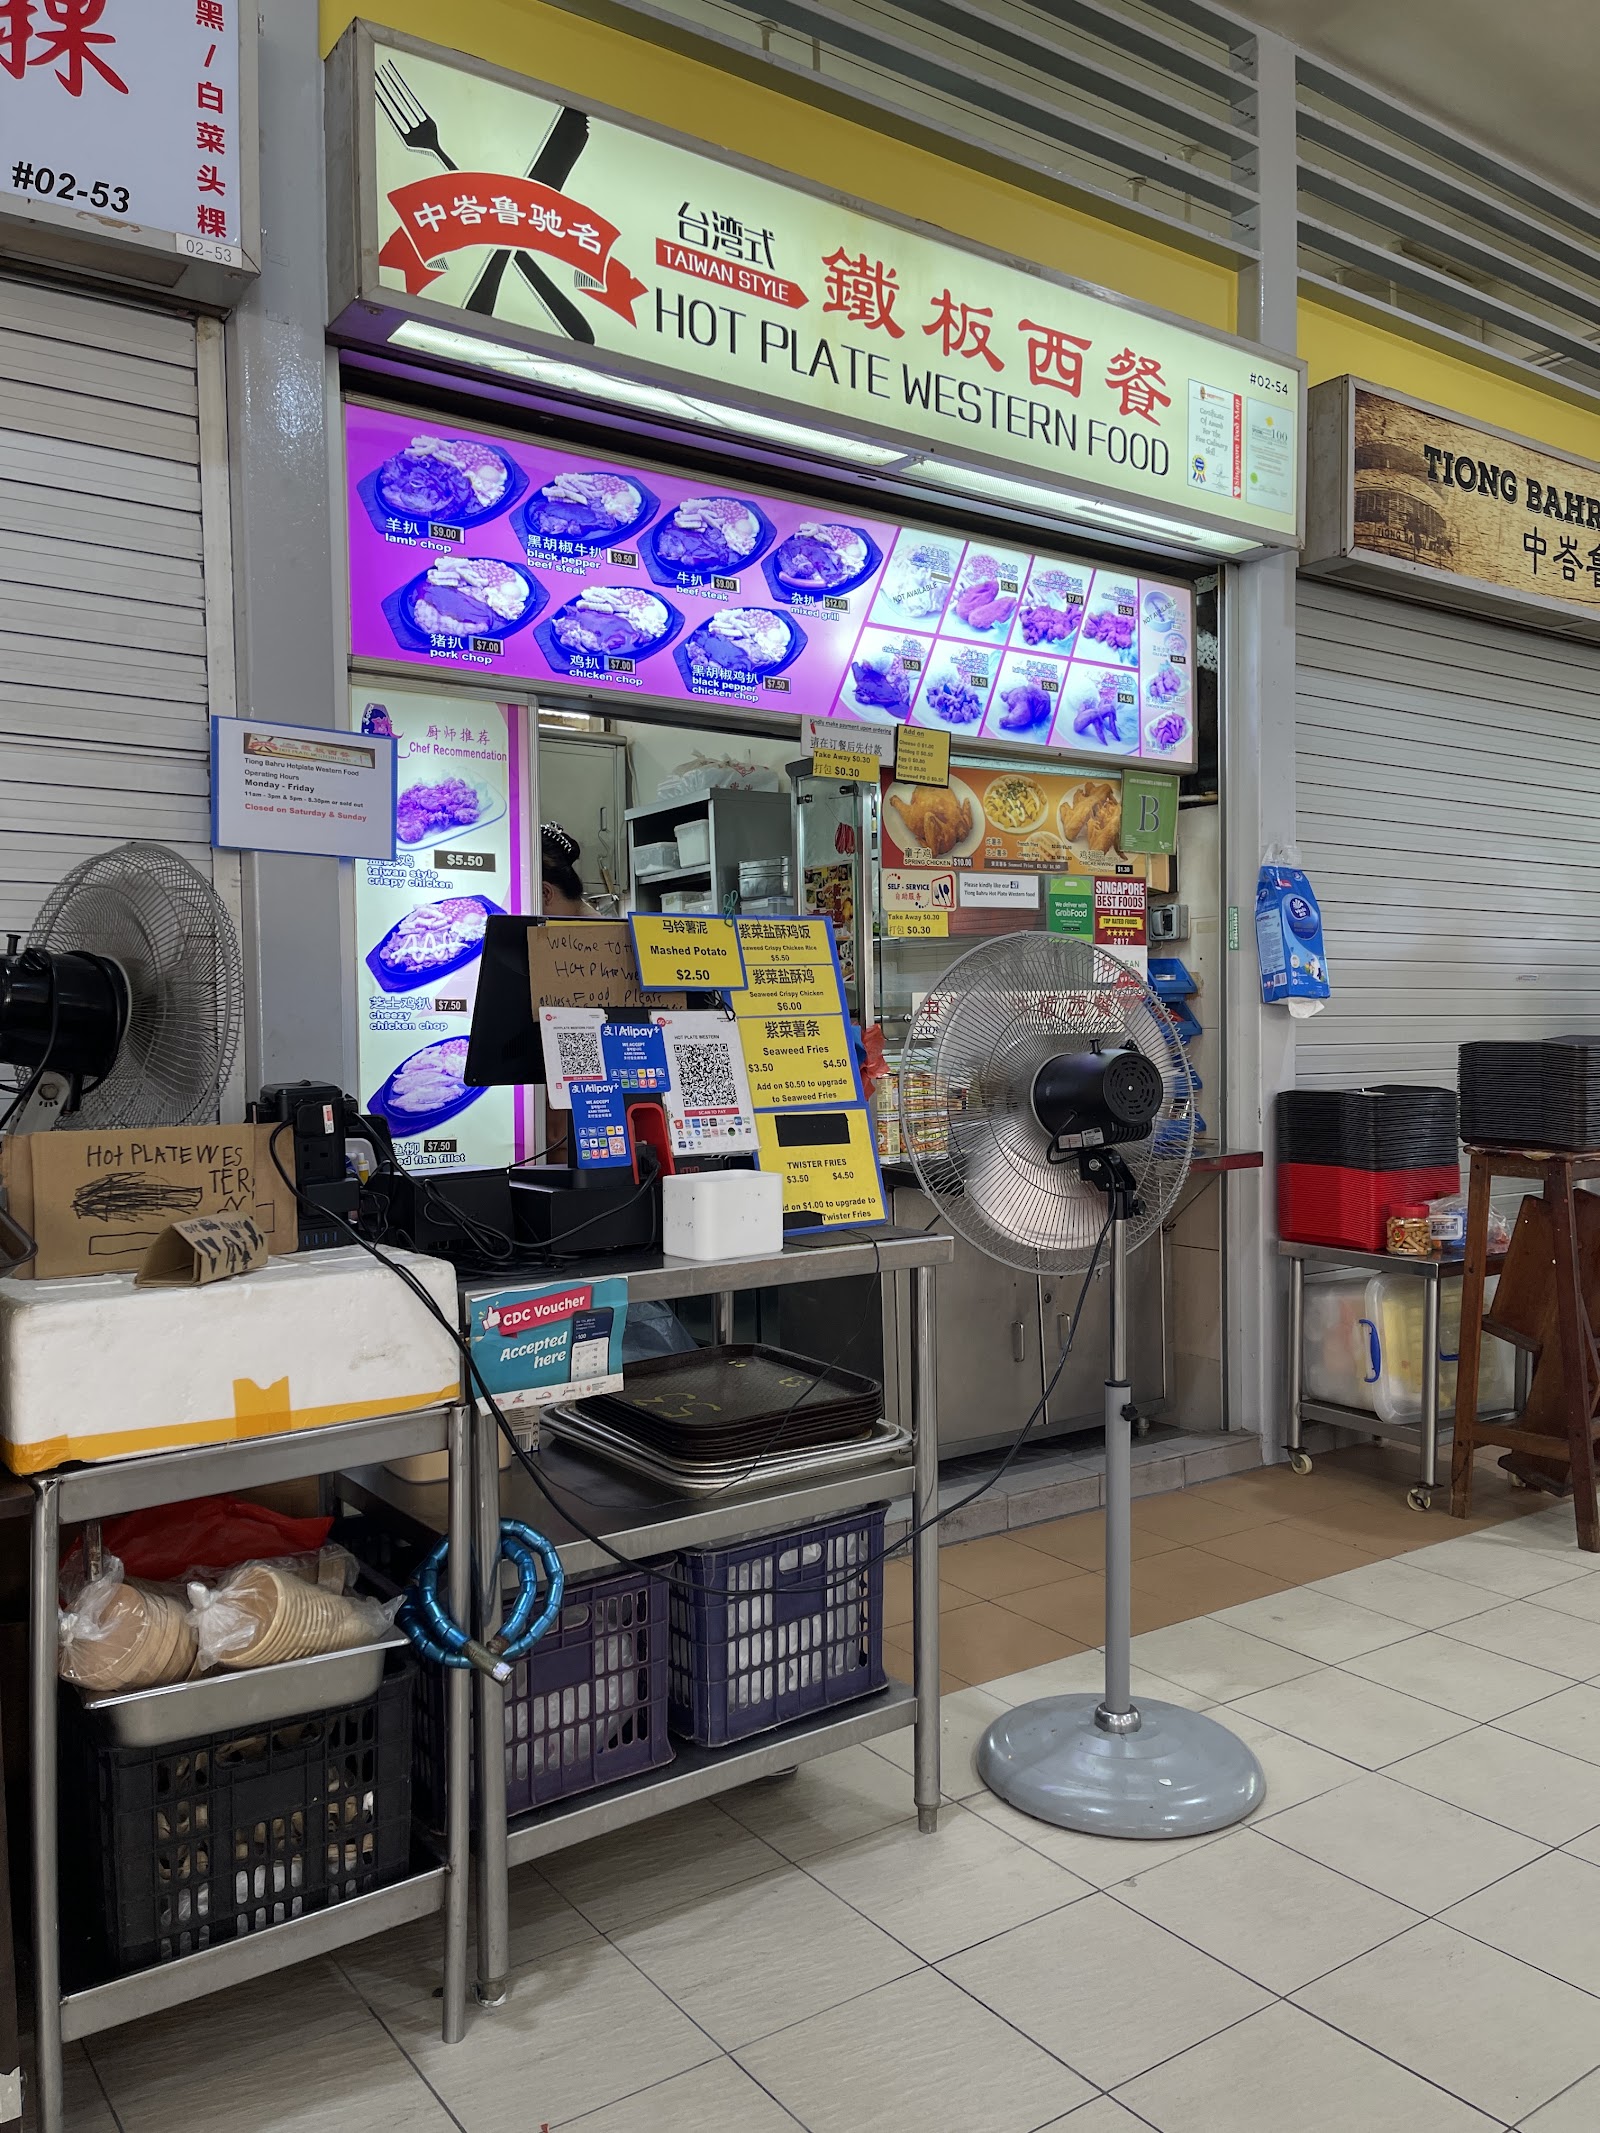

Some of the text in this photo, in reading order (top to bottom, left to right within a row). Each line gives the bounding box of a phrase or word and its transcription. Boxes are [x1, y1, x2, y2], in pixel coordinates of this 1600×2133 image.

[12, 160, 130, 213] #02-53
[412, 194, 602, 256] 中峇鲁驰名
[677, 201, 775, 270] 台湾式
[186, 239, 232, 263] 02-53
[663, 245, 789, 302] TAIWAN STYLE
[821, 245, 1172, 427] 鐵板西餐
[656, 287, 746, 354] HOT
[761, 320, 890, 399] PLATE
[901, 363, 1077, 451] WESTERN
[1088, 419, 1170, 476] FOOD
[1250, 372, 1288, 395] #02-54
[1424, 444, 1518, 504] TIONG
[386, 517, 420, 536] 羊扒
[433, 525, 457, 540] $9.00
[385, 532, 452, 553] lamb chop
[527, 534, 604, 560] 黑胡椒牛扒
[527, 548, 601, 570] black pepper
[613, 552, 633, 565] $9.50
[527, 558, 587, 577] beef steak
[676, 571, 703, 588] 牛扒
[715, 578, 735, 590] $9.00
[676, 585, 729, 602] beef steak
[791, 592, 816, 607] 杂扒
[893, 582, 938, 604] NOT AVAILABLE
[825, 598, 847, 610] $12.00
[790, 606, 840, 622] mixed grill
[430, 633, 463, 649] 猪扒
[476, 640, 499, 653] $7.00
[430, 648, 493, 666] pork chop
[569, 654, 600, 671] 鸡扒
[611, 659, 631, 671] $7.00
[569, 668, 643, 687] chicken chop
[692, 664, 759, 686] 黑胡椒鸡扒
[692, 676, 757, 694] black pepper
[767, 678, 786, 690] $7.50
[692, 686, 759, 703] chicken chop
[426, 724, 491, 746] 厨师推荐
[409, 742, 507, 762] Chef Recommendation
[814, 750, 871, 764] Take Away $0.30
[244, 769, 299, 781] Operating Hours
[814, 763, 860, 778] 打包 $0.30
[245, 779, 315, 794] Monday Friday
[245, 803, 274, 813] Closed
[276, 806, 287, 814] on
[289, 807, 327, 819] Saturday
[337, 812, 367, 822] Sunday
[1137, 794, 1160, 833] B
[905, 847, 932, 859] 童子鸡
[447, 855, 484, 867] $5.50
[953, 858, 972, 867] $10.00
[367, 867, 438, 881] taiwan style
[367, 877, 453, 890] crispy chicken
[905, 883, 930, 891] SERVICE
[1095, 881, 1145, 895] SINGAPORE
[895, 892, 922, 901] 自助服务
[1097, 895, 1143, 908] BEST FOODS
[1055, 909, 1087, 917] GrabFood
[663, 920, 708, 934] 马铃薯泥
[739, 923, 811, 939] 紫菜盐酥鸡饭
[907, 926, 931, 935] $0.30
[650, 945, 727, 957] Mashed Potato
[771, 954, 790, 962] $5.50
[676, 969, 710, 980] $2.50
[752, 968, 815, 984] 紫菜盐酥鸡
[369, 996, 432, 1011] 芝士鸡扒
[438, 1001, 461, 1012] $7.50
[777, 1001, 802, 1011] $6.00
[369, 1011, 411, 1021] cheezy
[369, 1021, 449, 1032] chicken chop
[765, 1019, 821, 1039] 紫菜薯条
[763, 1045, 829, 1056] Seaweed Fries
[748, 1059, 847, 1073] $3.50 $4.50
[757, 1082, 773, 1091] Add
[773, 1082, 783, 1090] on
[784, 1080, 806, 1089] $0.50
[817, 1078, 848, 1089] upgrade
[782, 1093, 817, 1103] Seaweed
[818, 1091, 837, 1100] Fries
[131, 1143, 191, 1165] PLATE
[428, 1141, 451, 1152] $7.50
[414, 1154, 436, 1165] fish
[439, 1153, 466, 1164] fillet
[787, 1158, 847, 1170] TWISTER FRIES
[786, 1171, 854, 1184] $3.50 $4.50
[803, 1200, 824, 1210] $1.00
[835, 1197, 866, 1208] upgrade
[822, 1210, 871, 1221] Twister Fries
[503, 1295, 585, 1327] CDC Voucher
[500, 1331, 568, 1361] Accepted
[534, 1351, 566, 1369] here
